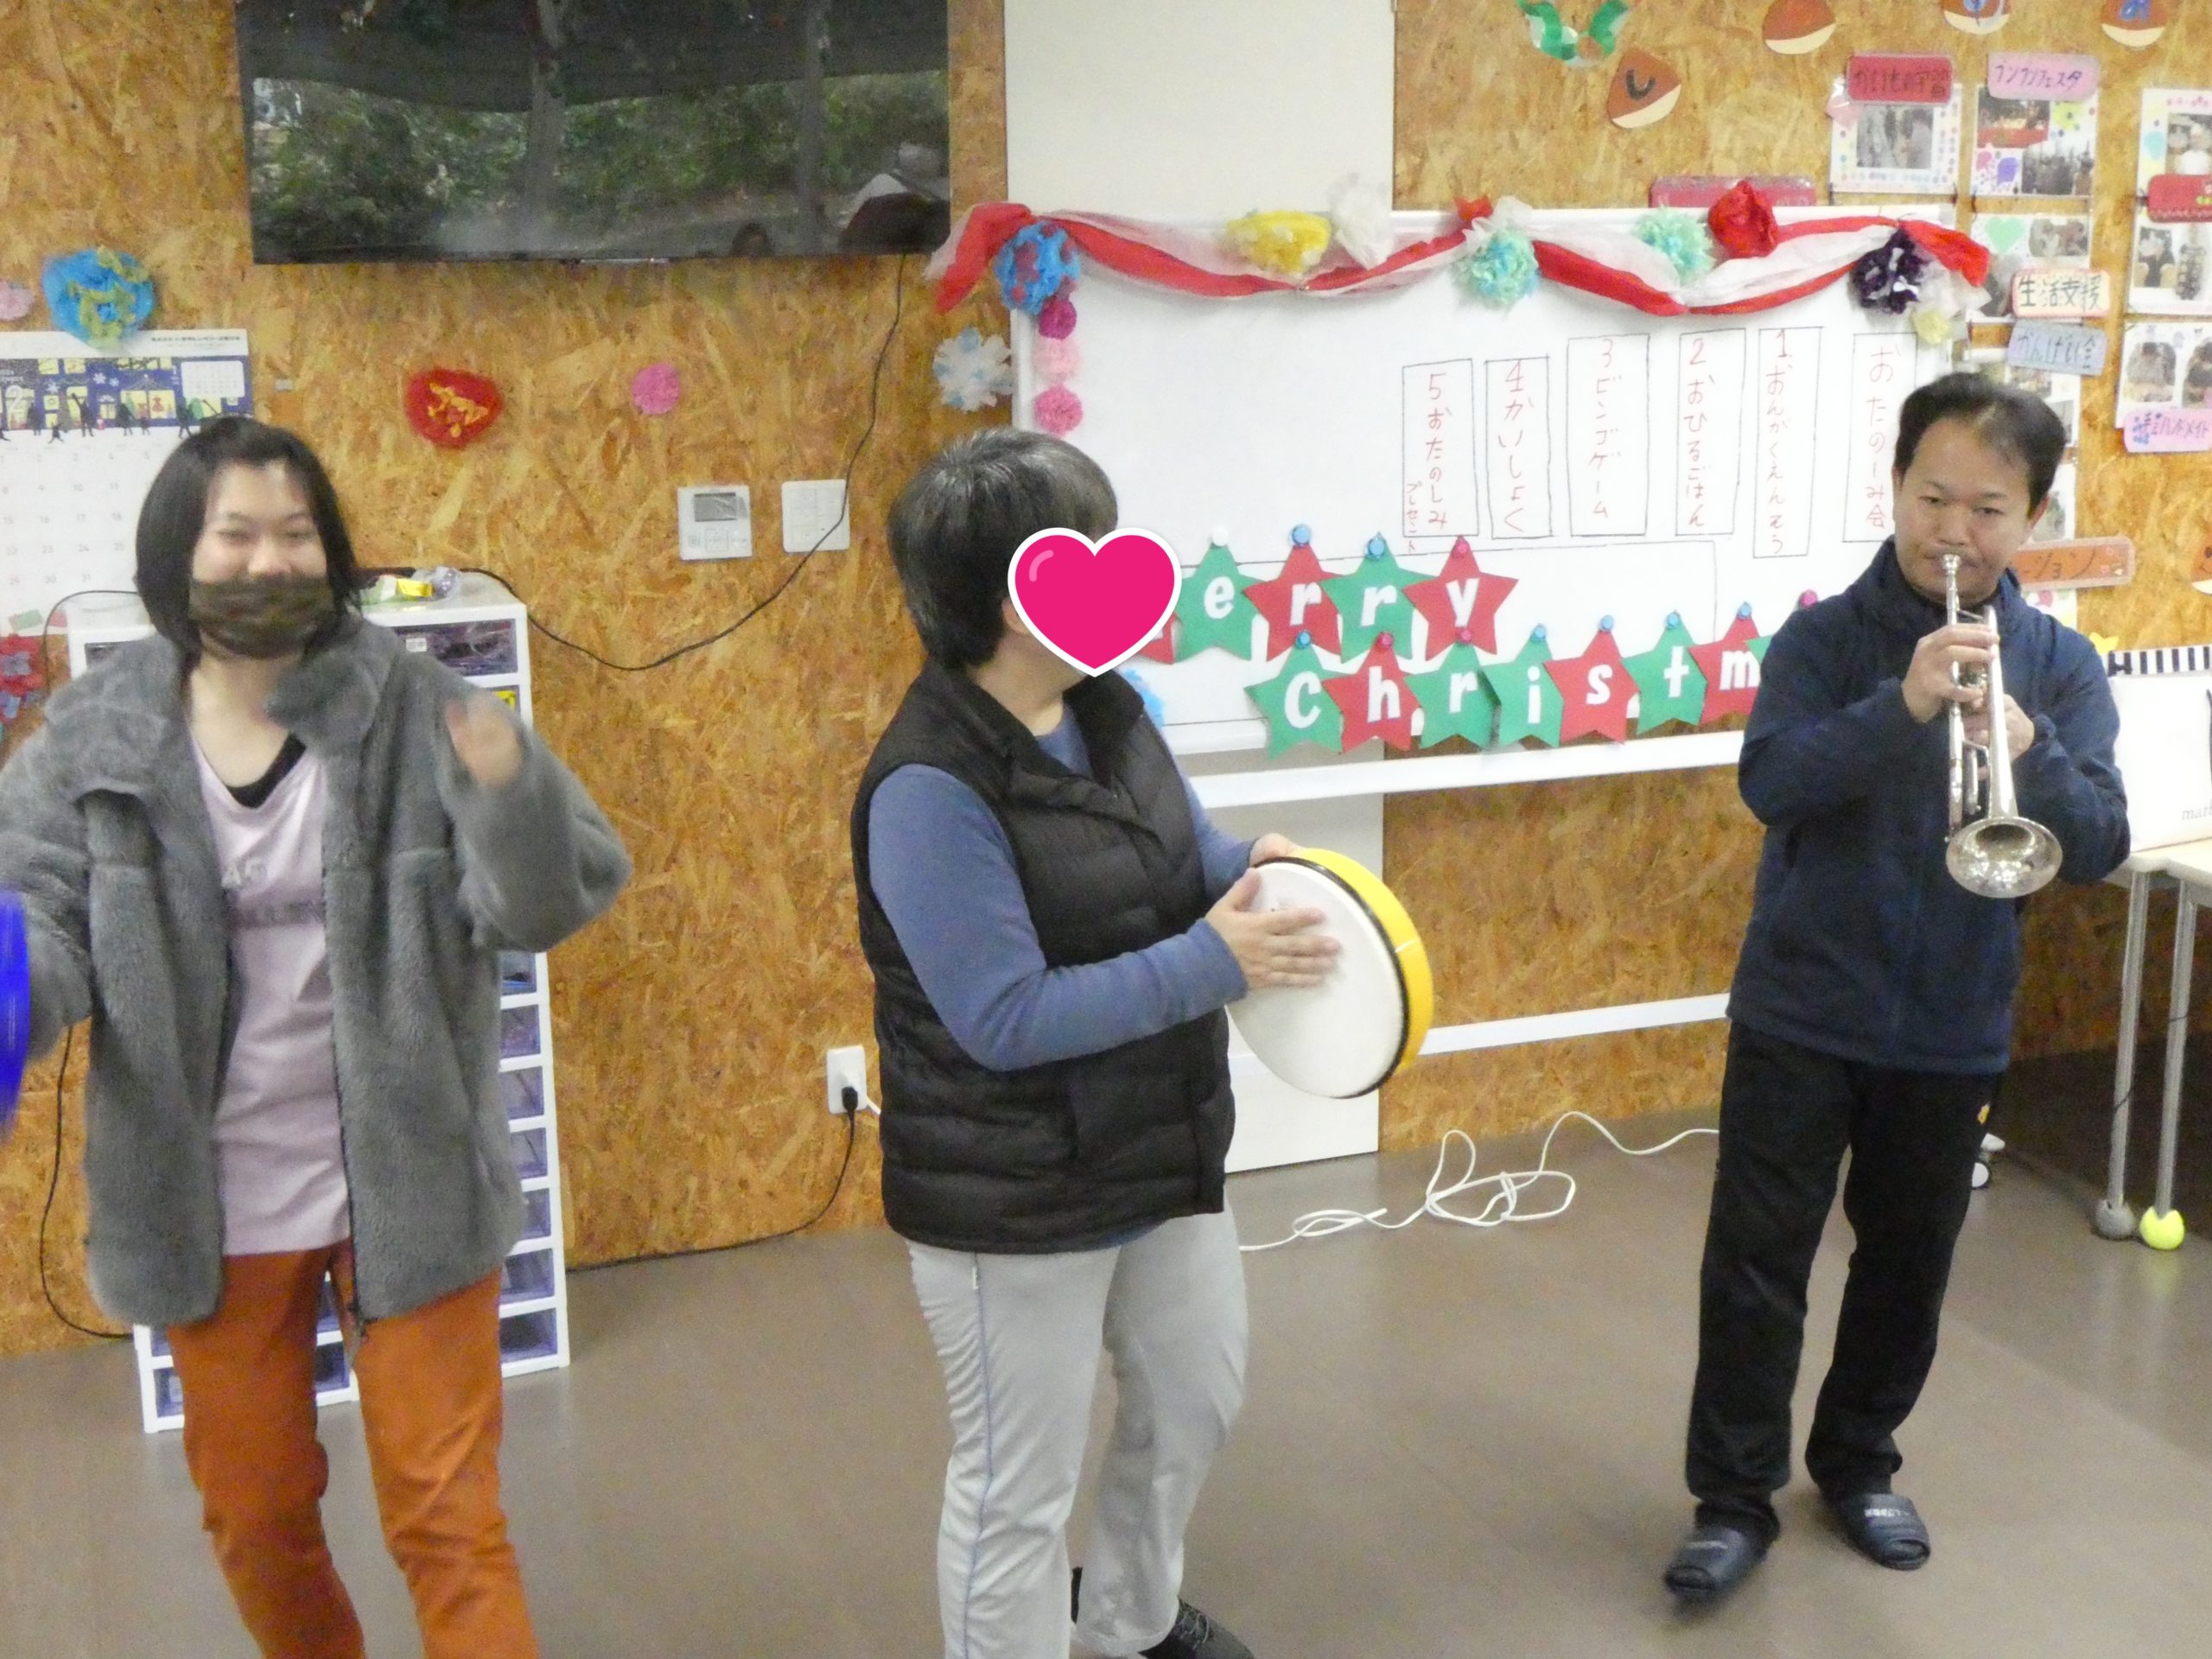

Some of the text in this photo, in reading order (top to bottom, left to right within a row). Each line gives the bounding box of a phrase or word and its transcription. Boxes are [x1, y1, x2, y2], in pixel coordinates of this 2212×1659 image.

[2018, 274, 2102, 311] 生活支援
[1153, 575, 1481, 642] erry
